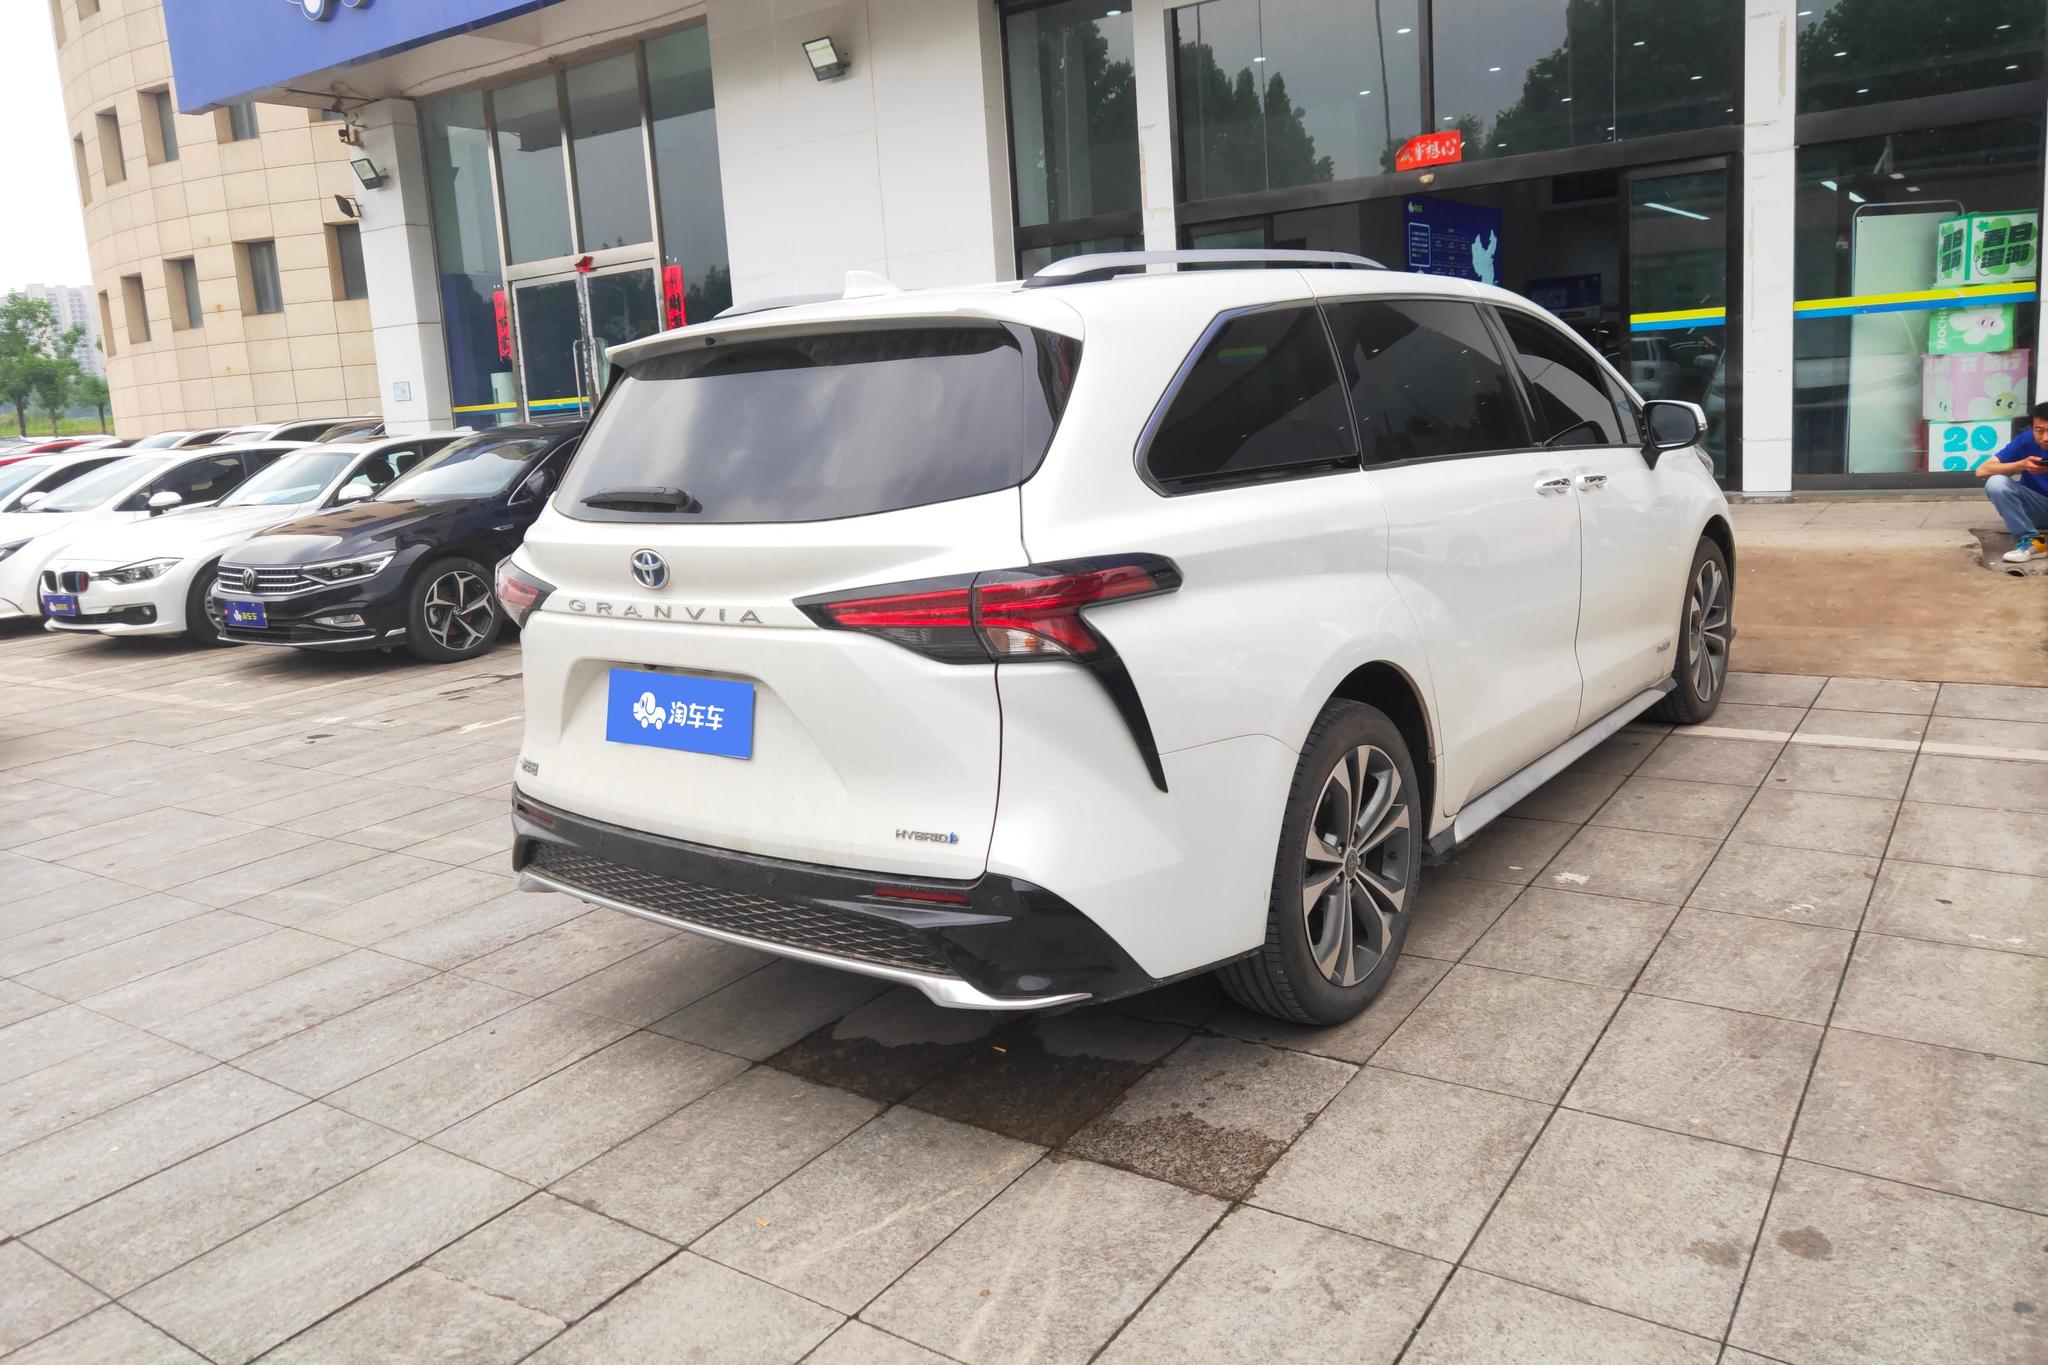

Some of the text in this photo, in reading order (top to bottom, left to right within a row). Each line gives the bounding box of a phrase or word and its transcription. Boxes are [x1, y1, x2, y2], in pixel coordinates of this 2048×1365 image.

[1942, 425, 1998, 453] 20
[568, 599, 763, 624] GRANVIA
[667, 701, 725, 731] 淘车车
[895, 829, 948, 844] HYBRID
